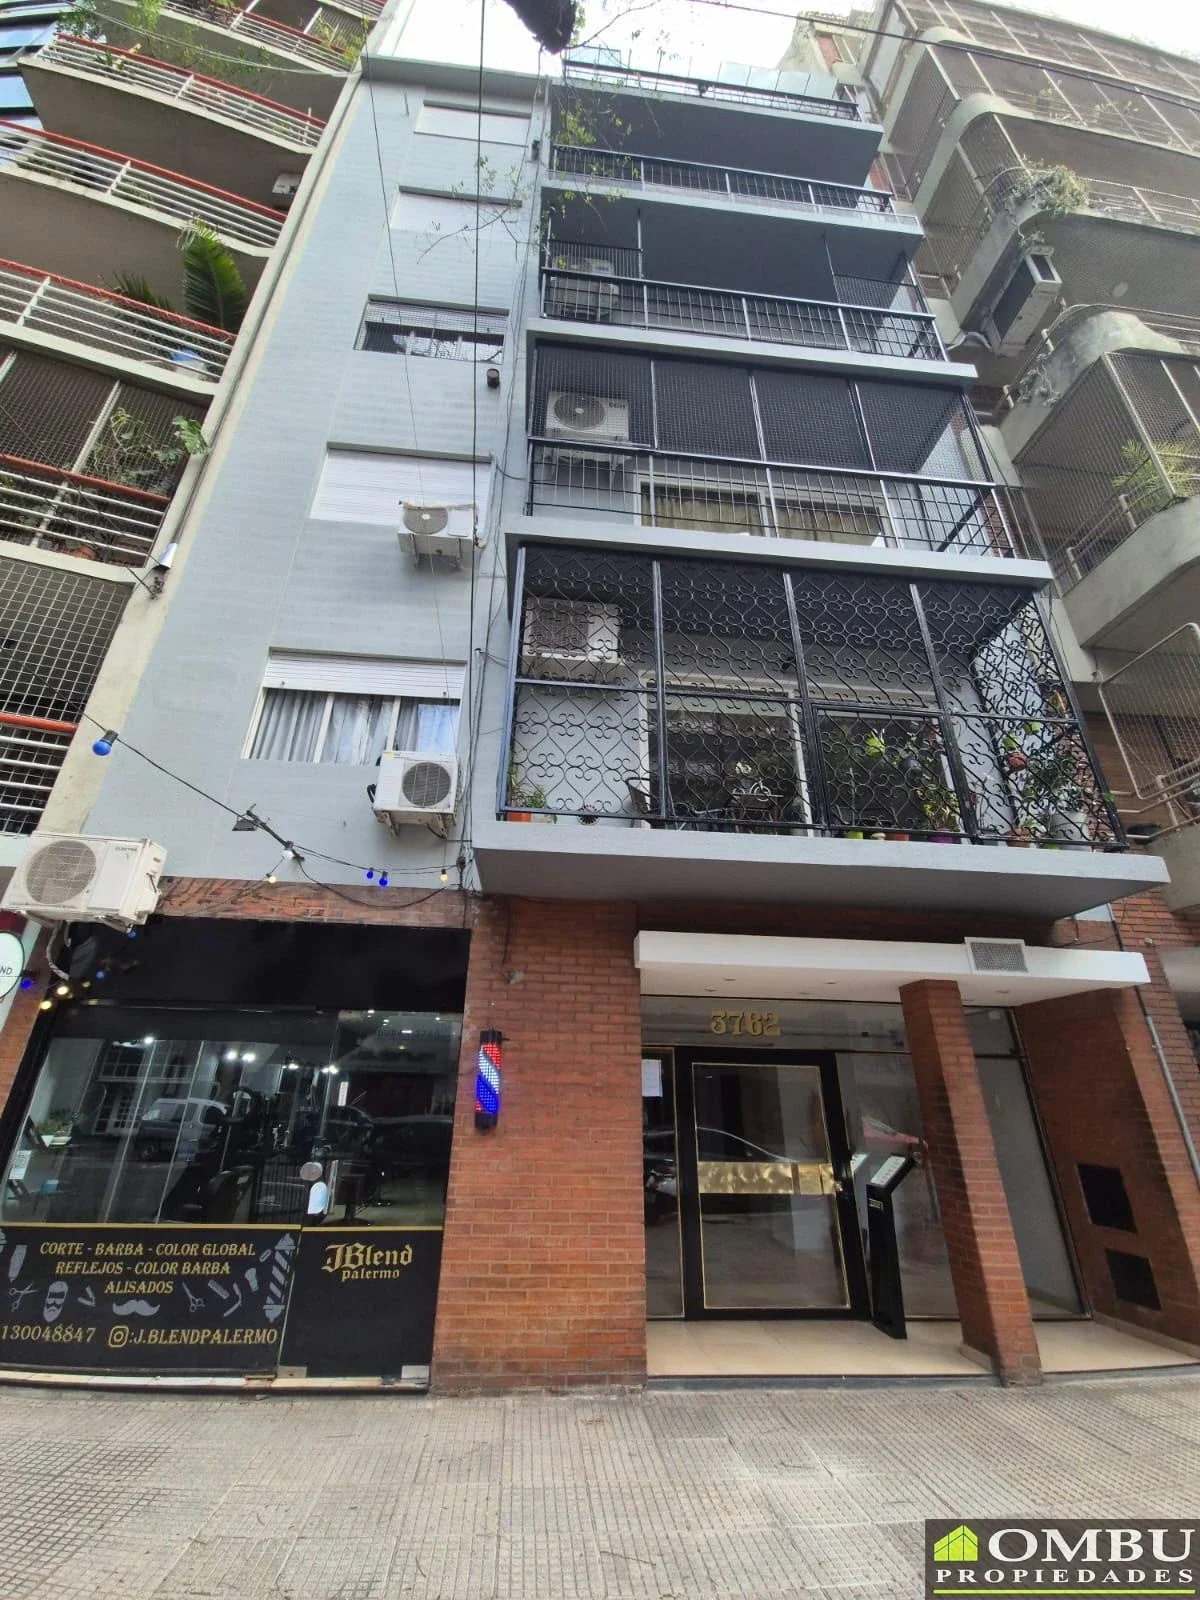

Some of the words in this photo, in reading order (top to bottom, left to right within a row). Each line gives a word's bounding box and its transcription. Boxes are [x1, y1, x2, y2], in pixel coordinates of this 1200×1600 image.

[711, 1009, 784, 1036] 3762
[40, 1242, 84, 1256] CORTE
[94, 1242, 144, 1256] BARBA
[155, 1243, 199, 1256] COLOR
[202, 1243, 256, 1256] GLOBAL
[55, 1261, 124, 1275] REFLEJOS
[134, 1261, 179, 1275] COLOR
[181, 1261, 230, 1275] BARBA
[341, 1267, 400, 1282] palermo
[104, 1281, 175, 1294] ALISADOS
[1, 1324, 97, 1342] 130048847
